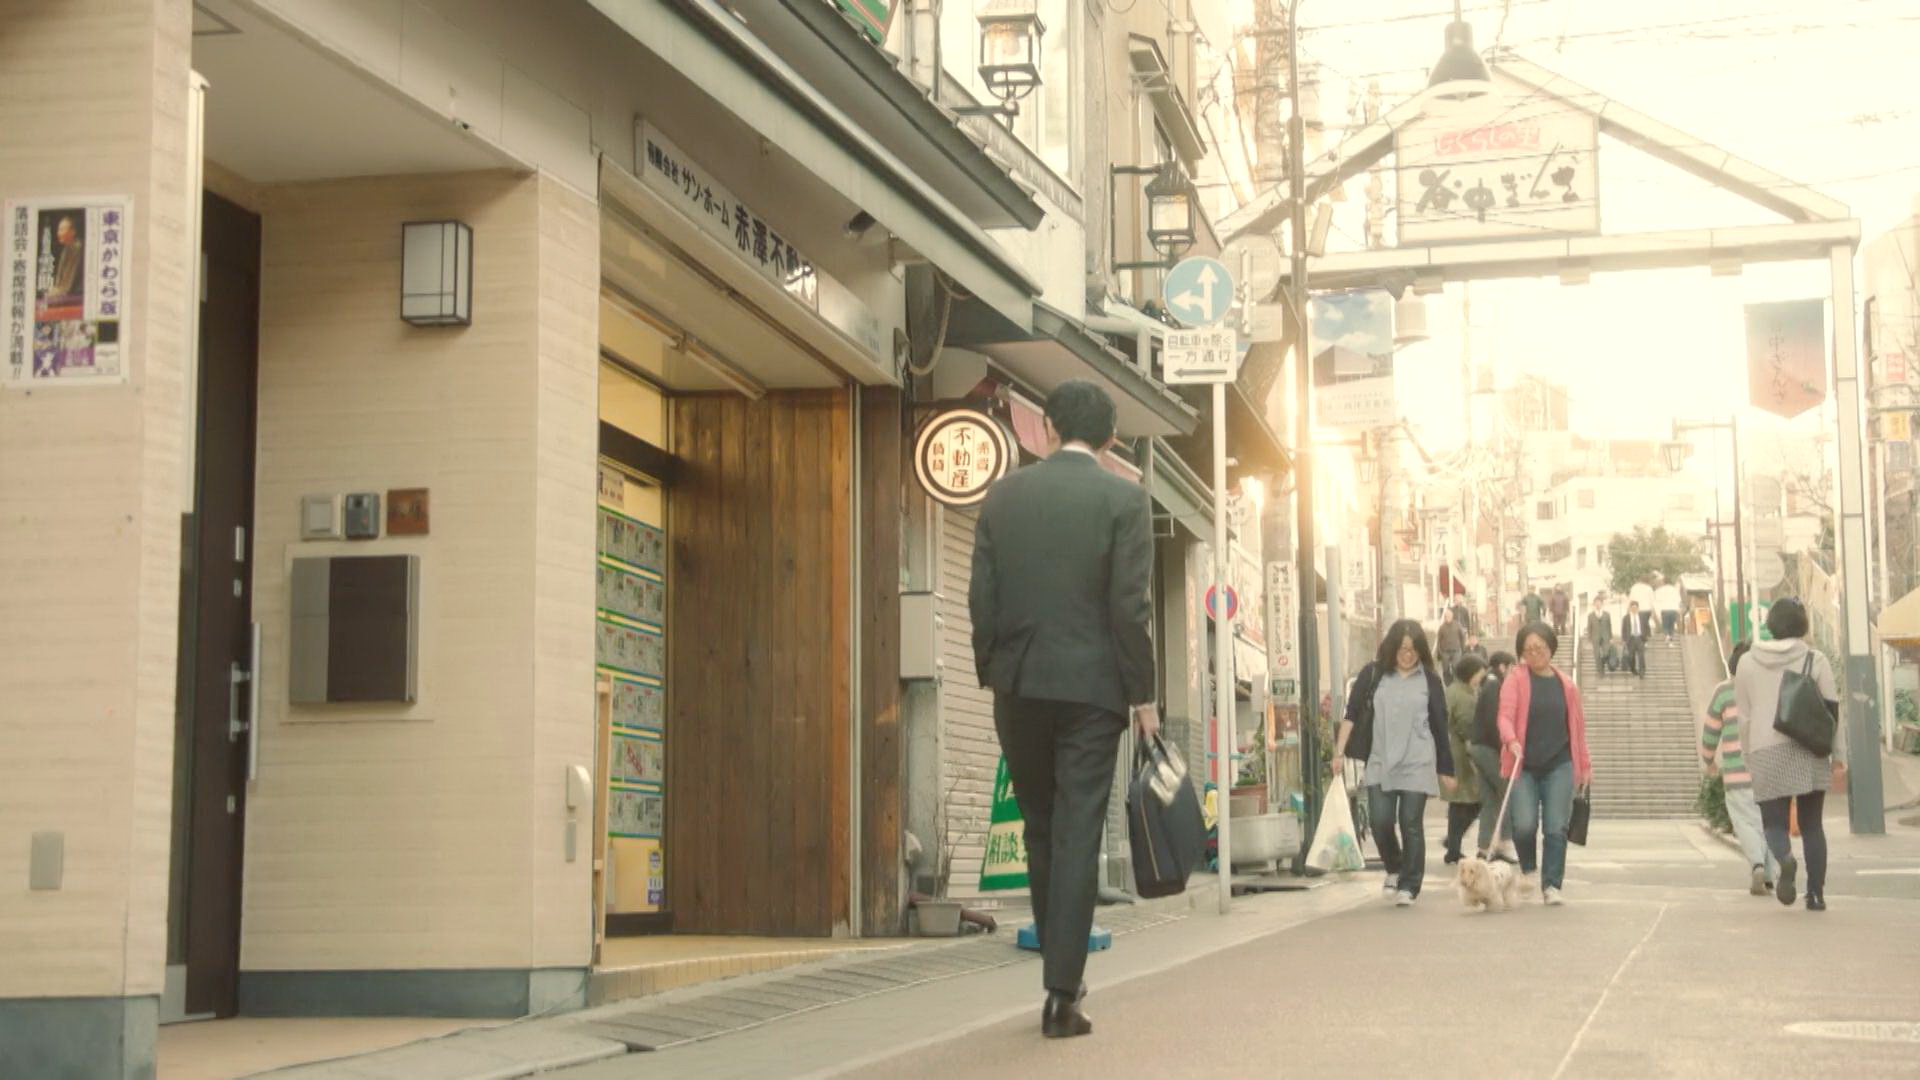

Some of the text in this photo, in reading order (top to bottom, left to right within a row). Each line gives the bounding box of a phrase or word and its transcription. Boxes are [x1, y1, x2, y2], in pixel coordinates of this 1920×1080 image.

[101, 210, 120, 315] 東京かわら版
[1168, 349, 1231, 363] 一方通行
[952, 427, 971, 489] 不動産
